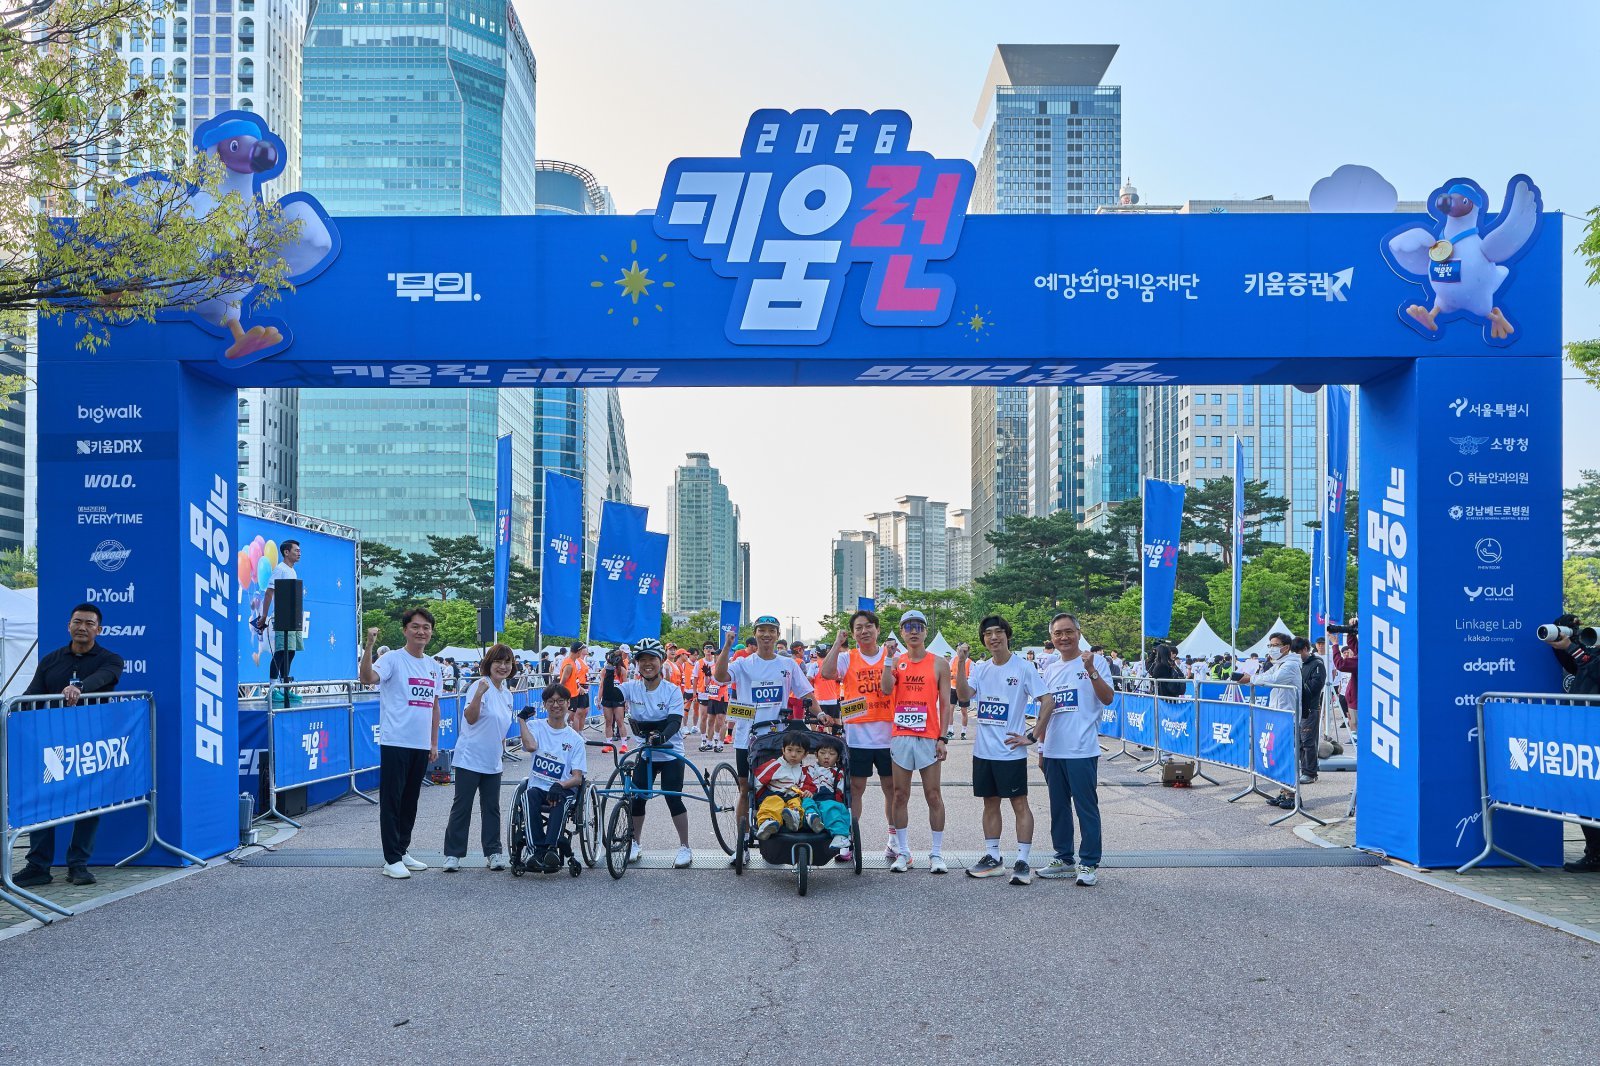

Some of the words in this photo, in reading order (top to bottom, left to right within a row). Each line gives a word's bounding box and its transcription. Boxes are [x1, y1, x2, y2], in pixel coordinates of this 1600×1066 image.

[755, 123, 898, 154] 2026
[1033, 267, 1201, 303] 예강희망키움재단
[501, 367, 661, 384] 2026
[77, 404, 143, 424] bigwalk
[1469, 403, 1529, 418] 서울특별시
[90, 439, 143, 455] 키움DRX
[1490, 437, 1529, 452] 소방청
[84, 474, 137, 489] WOLO.
[1467, 472, 1529, 485] 하늘안과의원
[1465, 505, 1530, 517] 강남베드로병원
[86, 587, 128, 603] Dr.You
[1455, 618, 1499, 632] Linkage
[1502, 618, 1522, 630] Lab
[1467, 634, 1490, 642] kakao
[1463, 657, 1516, 676] adapfit
[905, 675, 925, 683] VMK
[195, 613, 224, 766] 2026
[411, 686, 434, 698] 0264
[755, 688, 780, 699] 0017
[1371, 614, 1401, 769] 2026
[979, 703, 1006, 716] 0429
[897, 714, 924, 724] 3595
[535, 757, 562, 774] 0006
